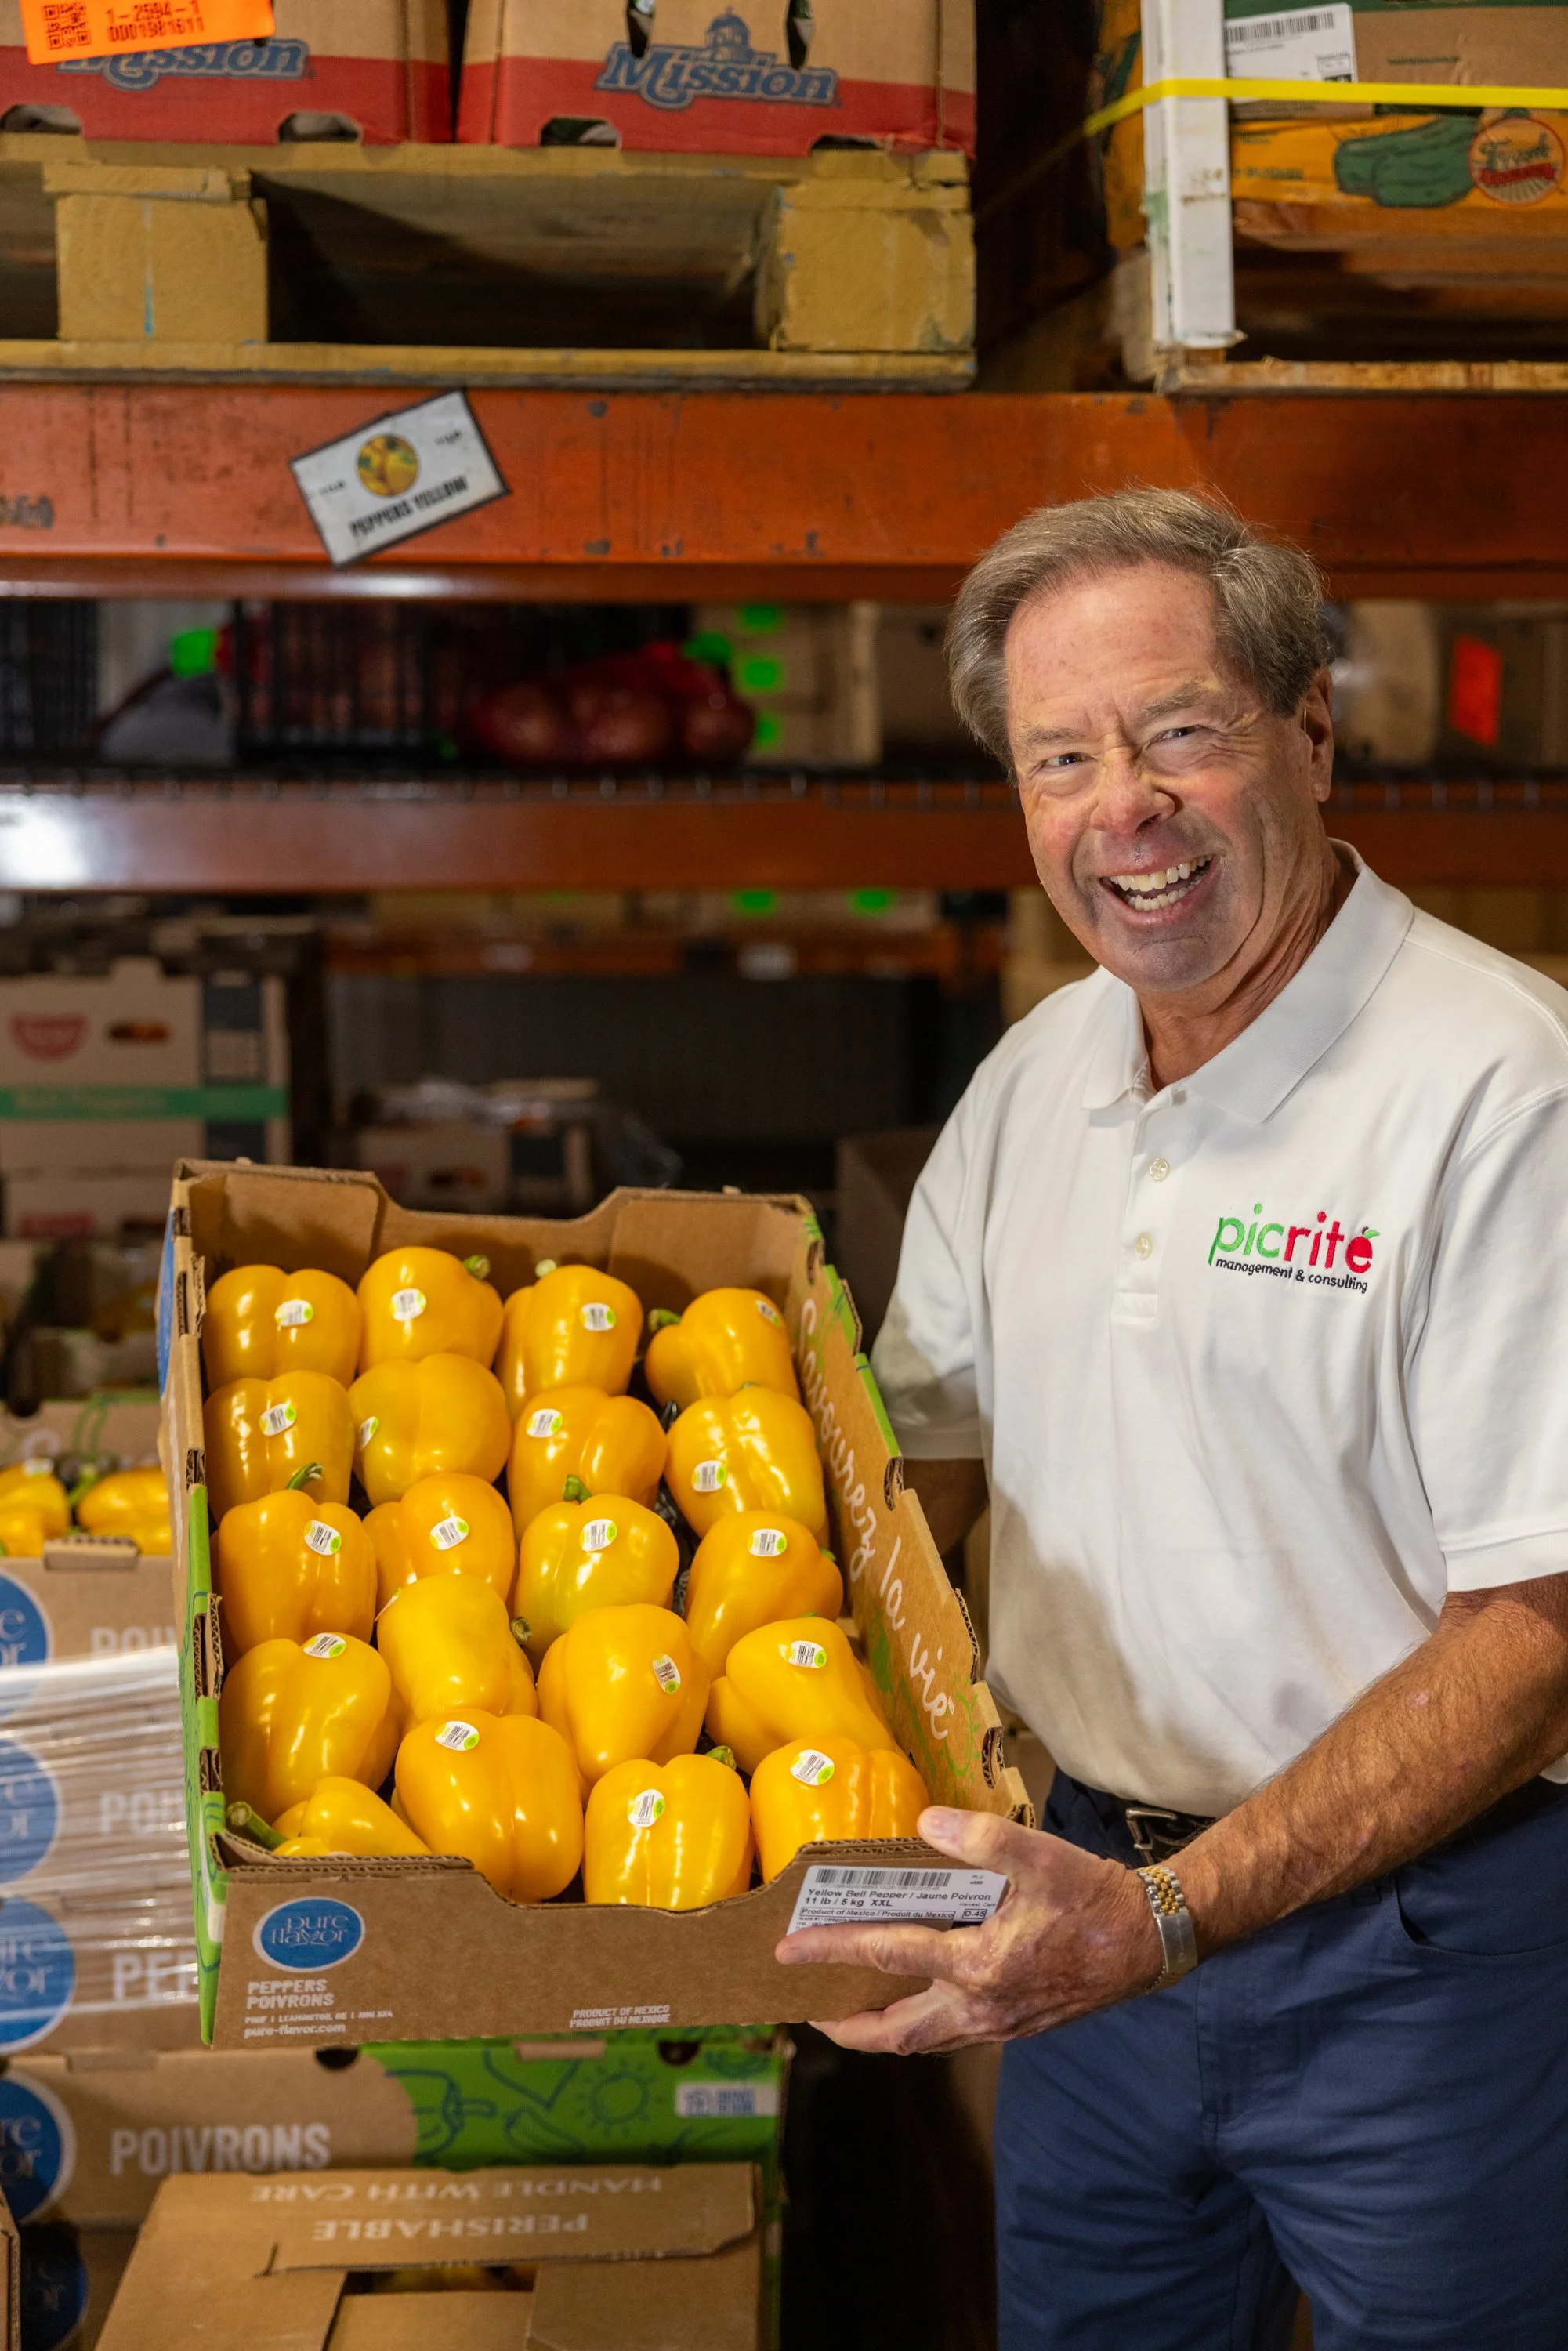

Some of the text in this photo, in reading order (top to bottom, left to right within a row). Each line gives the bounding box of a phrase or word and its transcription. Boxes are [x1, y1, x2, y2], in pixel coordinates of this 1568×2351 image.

[605, 50, 833, 103] Mission
[349, 474, 469, 538] PEPPERS YELLOW
[1208, 1203, 1376, 1274] picrite
[1216, 1257, 1368, 1294] management & consulting
[793, 1298, 878, 1583] Savourez
[878, 1534, 907, 1632] la
[804, 1896, 817, 1905] 11
[820, 1896, 831, 1905] lb
[850, 1897, 864, 1908] kg
[870, 1899, 893, 1907] XXL
[807, 1889, 845, 1899] Yellow
[846, 1889, 866, 1899] Bell
[868, 1890, 908, 1900] Pepper
[916, 1892, 948, 1901] Jaune
[951, 1893, 992, 1901] Poivron
[802, 1908, 835, 1917] Product
[882, 1910, 914, 1918] Produit
[925, 1911, 954, 1919] Mexico
[287, 1914, 349, 1934] pure
[270, 1927, 349, 1947] flavor
[248, 1979, 328, 1995] PEPPERS
[246, 1993, 335, 2010] POIVRONS
[570, 2016, 613, 2028] PRODUIT
[614, 2016, 628, 2025] DU
[573, 2005, 671, 2019] PRODUCT OF MEXICO
[244, 2024, 346, 2039] pure-flavor.com
[110, 2121, 331, 2175] POIVRONS
[250, 2176, 664, 2203] HANDLE WITH CARE
[312, 2213, 589, 2242] PERISHABLE
